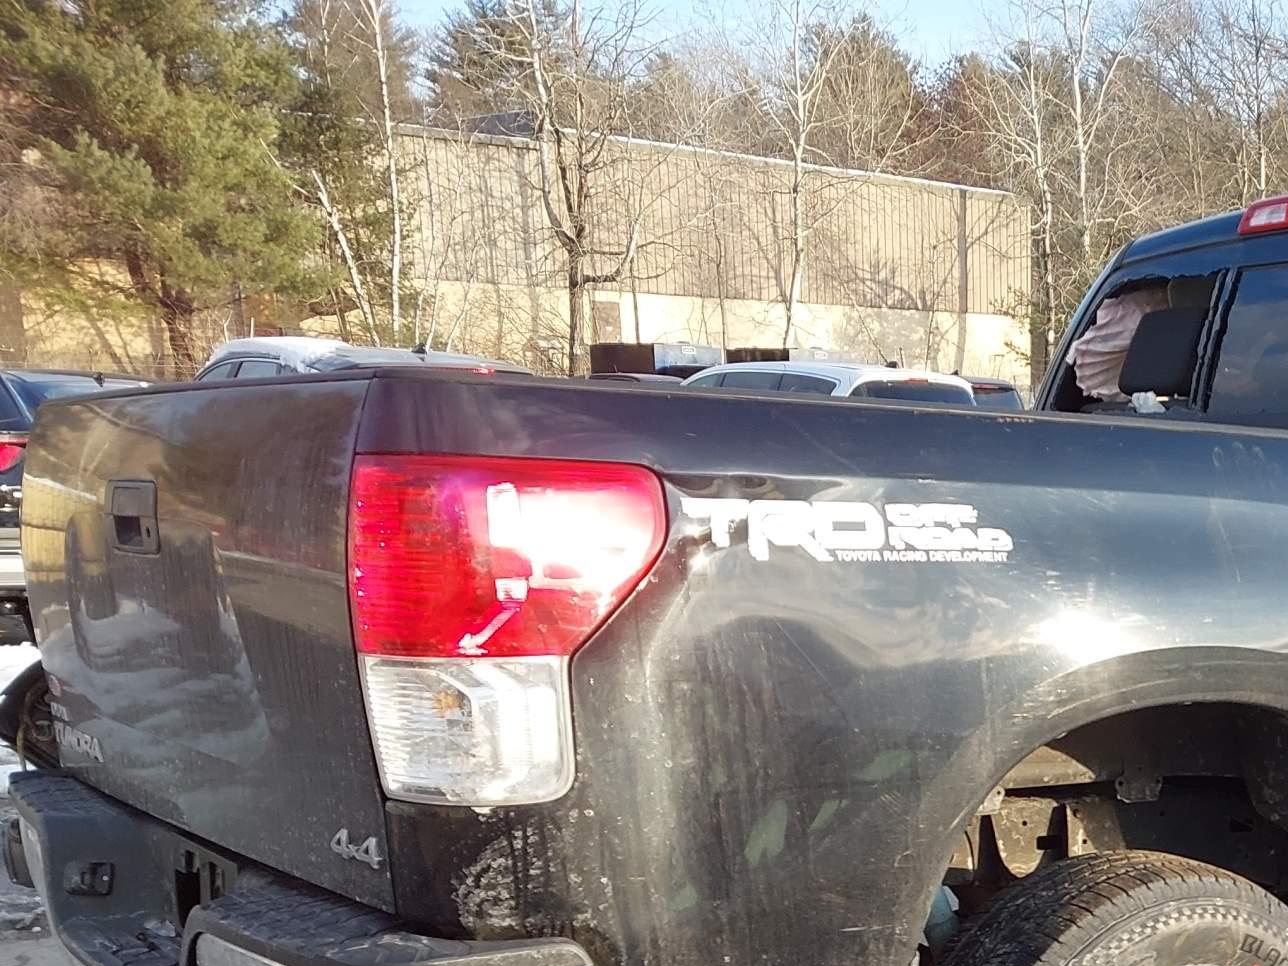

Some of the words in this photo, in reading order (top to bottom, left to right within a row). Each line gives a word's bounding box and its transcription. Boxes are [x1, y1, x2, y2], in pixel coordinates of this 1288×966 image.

[680, 497, 887, 562] TRD
[887, 526, 1013, 551] ROAD
[837, 550, 882, 562] TOYOTA
[883, 550, 928, 562] RACING
[929, 550, 1008, 562] DEVELOPMENT
